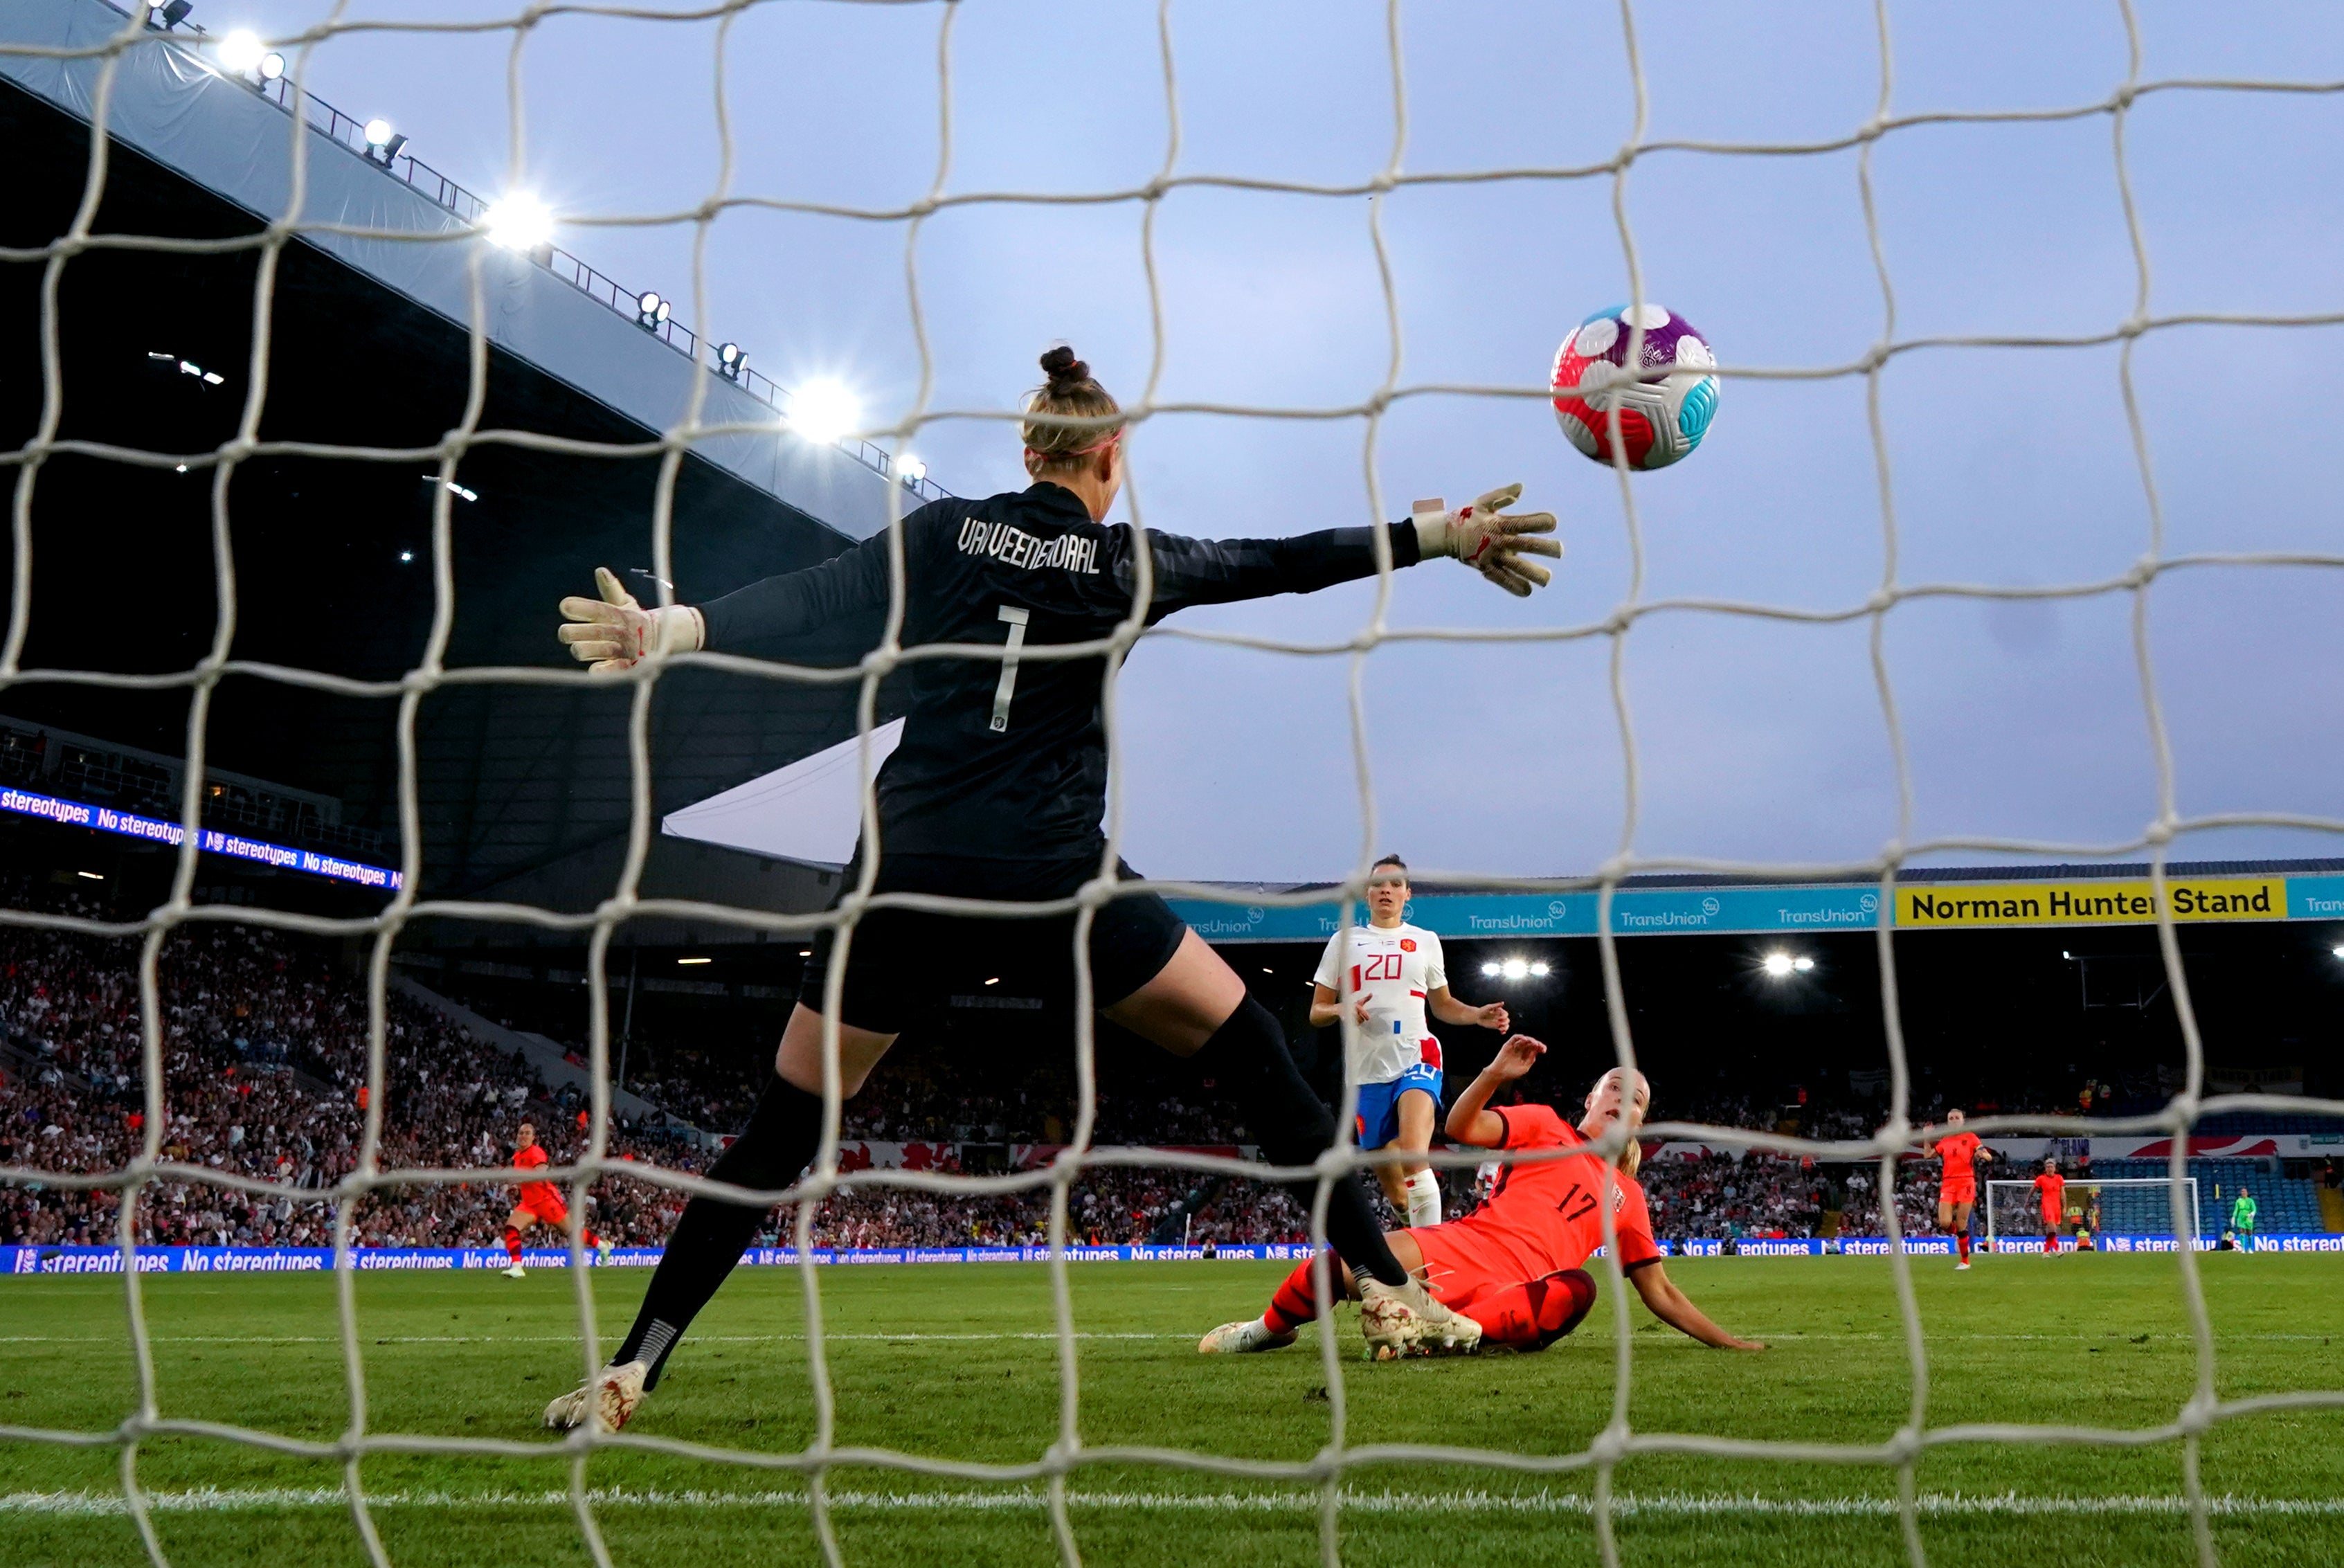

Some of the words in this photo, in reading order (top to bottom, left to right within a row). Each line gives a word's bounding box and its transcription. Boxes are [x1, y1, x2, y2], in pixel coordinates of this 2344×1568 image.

[989, 604, 1030, 732] 1
[1, 790, 89, 823] stereotypes
[98, 809, 118, 829] No
[120, 815, 199, 845] stereotyps
[226, 838, 297, 865] stereotypes
[303, 851, 320, 871] No
[321, 857, 386, 885] stereotypes
[1778, 908, 1866, 923] TransUnion
[1913, 894, 2040, 919] Norman
[2173, 885, 2271, 914] Stand
[1469, 914, 1553, 929] TransUnion
[1621, 912, 1708, 926] TransUnion
[1365, 954, 1402, 980] 20
[1556, 1183, 1597, 1223] 17
[1130, 1247, 1154, 1260] No
[2255, 1236, 2279, 1251] No
